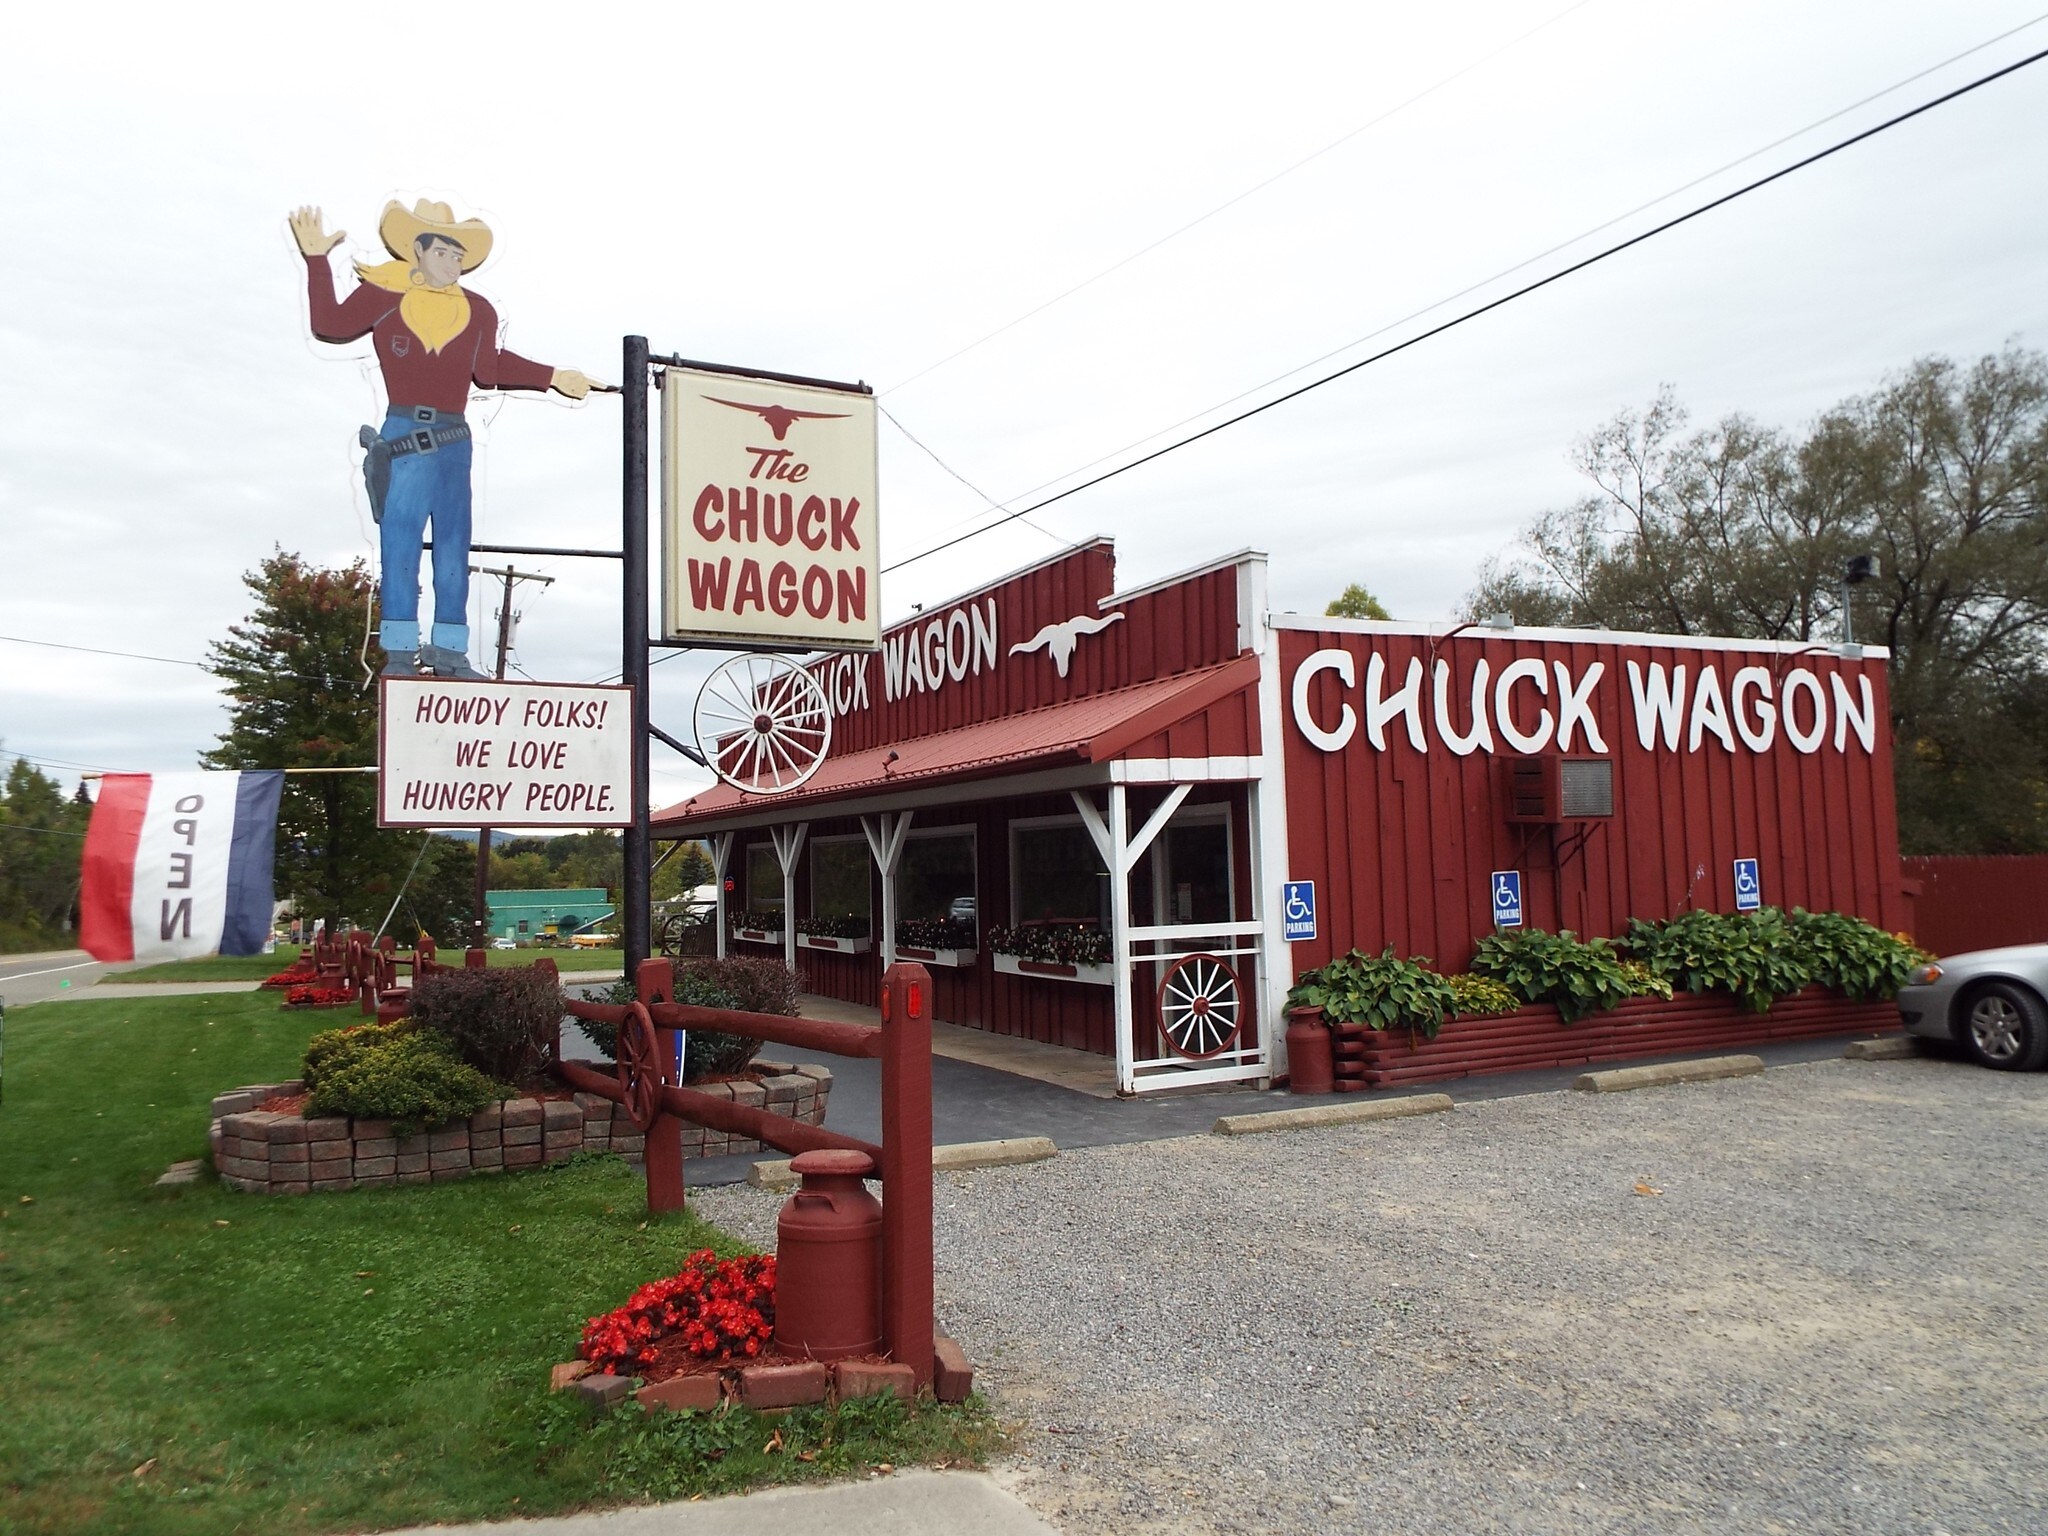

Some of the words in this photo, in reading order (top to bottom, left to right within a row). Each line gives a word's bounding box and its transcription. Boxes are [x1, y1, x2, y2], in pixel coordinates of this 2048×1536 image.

[745, 446, 809, 483] The
[693, 484, 861, 551] CHUCK
[687, 556, 866, 623] WAGON
[882, 597, 997, 702] WAGON
[415, 693, 511, 726] HOWDY
[523, 699, 608, 730] FOLKS!
[1292, 648, 1609, 756] CHUCK
[1626, 659, 1875, 755] WAGON
[456, 739, 492, 768] WE
[507, 740, 568, 770] LOVE
[402, 779, 513, 812] HUNGRY
[525, 782, 615, 812] PEOPLE.
[1286, 921, 1314, 934] PARKING
